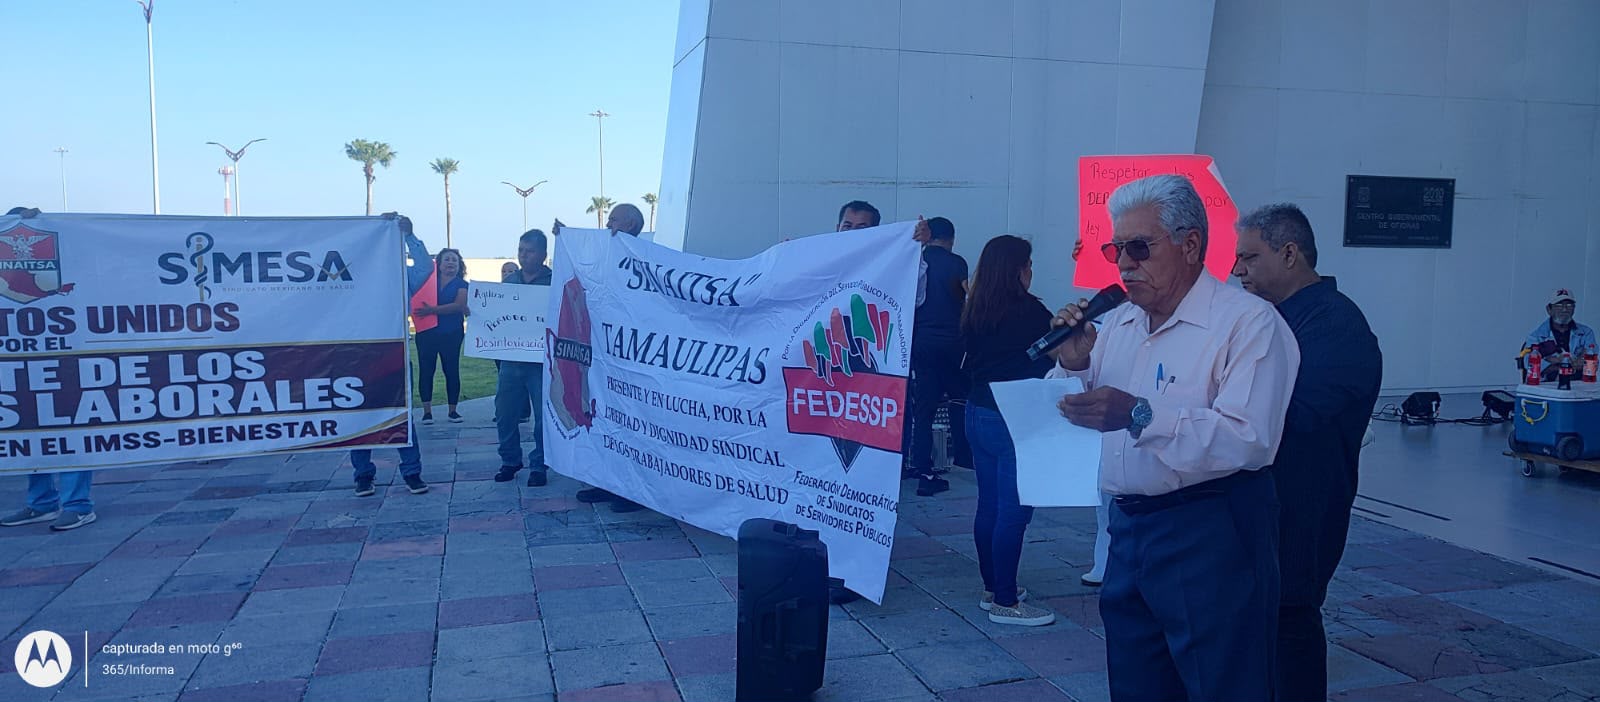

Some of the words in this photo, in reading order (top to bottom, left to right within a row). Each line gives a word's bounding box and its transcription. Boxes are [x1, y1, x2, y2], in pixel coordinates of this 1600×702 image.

[1090, 162, 1151, 183] Respetar
[1205, 195, 1230, 208] por
[883, 292, 889, 301] Y
[86, 302, 240, 334] UNIDOS
[45, 336, 72, 351] EL
[602, 322, 770, 385] TAMAULIPAS
[0, 359, 61, 391] TE
[78, 355, 151, 389] DE
[168, 350, 266, 383] LOS
[36, 376, 365, 427] LABORALES
[644, 388, 650, 404] Y
[651, 390, 664, 409] EN
[665, 394, 710, 422] LUCHA,
[713, 404, 745, 425] POR
[746, 409, 768, 428] LA
[793, 387, 897, 428] FEDESSP
[41, 436, 76, 456] EL
[84, 419, 338, 453] IMSS-BIENESTAR
[640, 420, 648, 435] Y
[649, 422, 709, 452] DIGNIDAD
[712, 438, 785, 468] SINDICAL
[629, 446, 712, 488] TRABAJADORES
[715, 473, 735, 493] DE
[737, 479, 789, 505] SALUD
